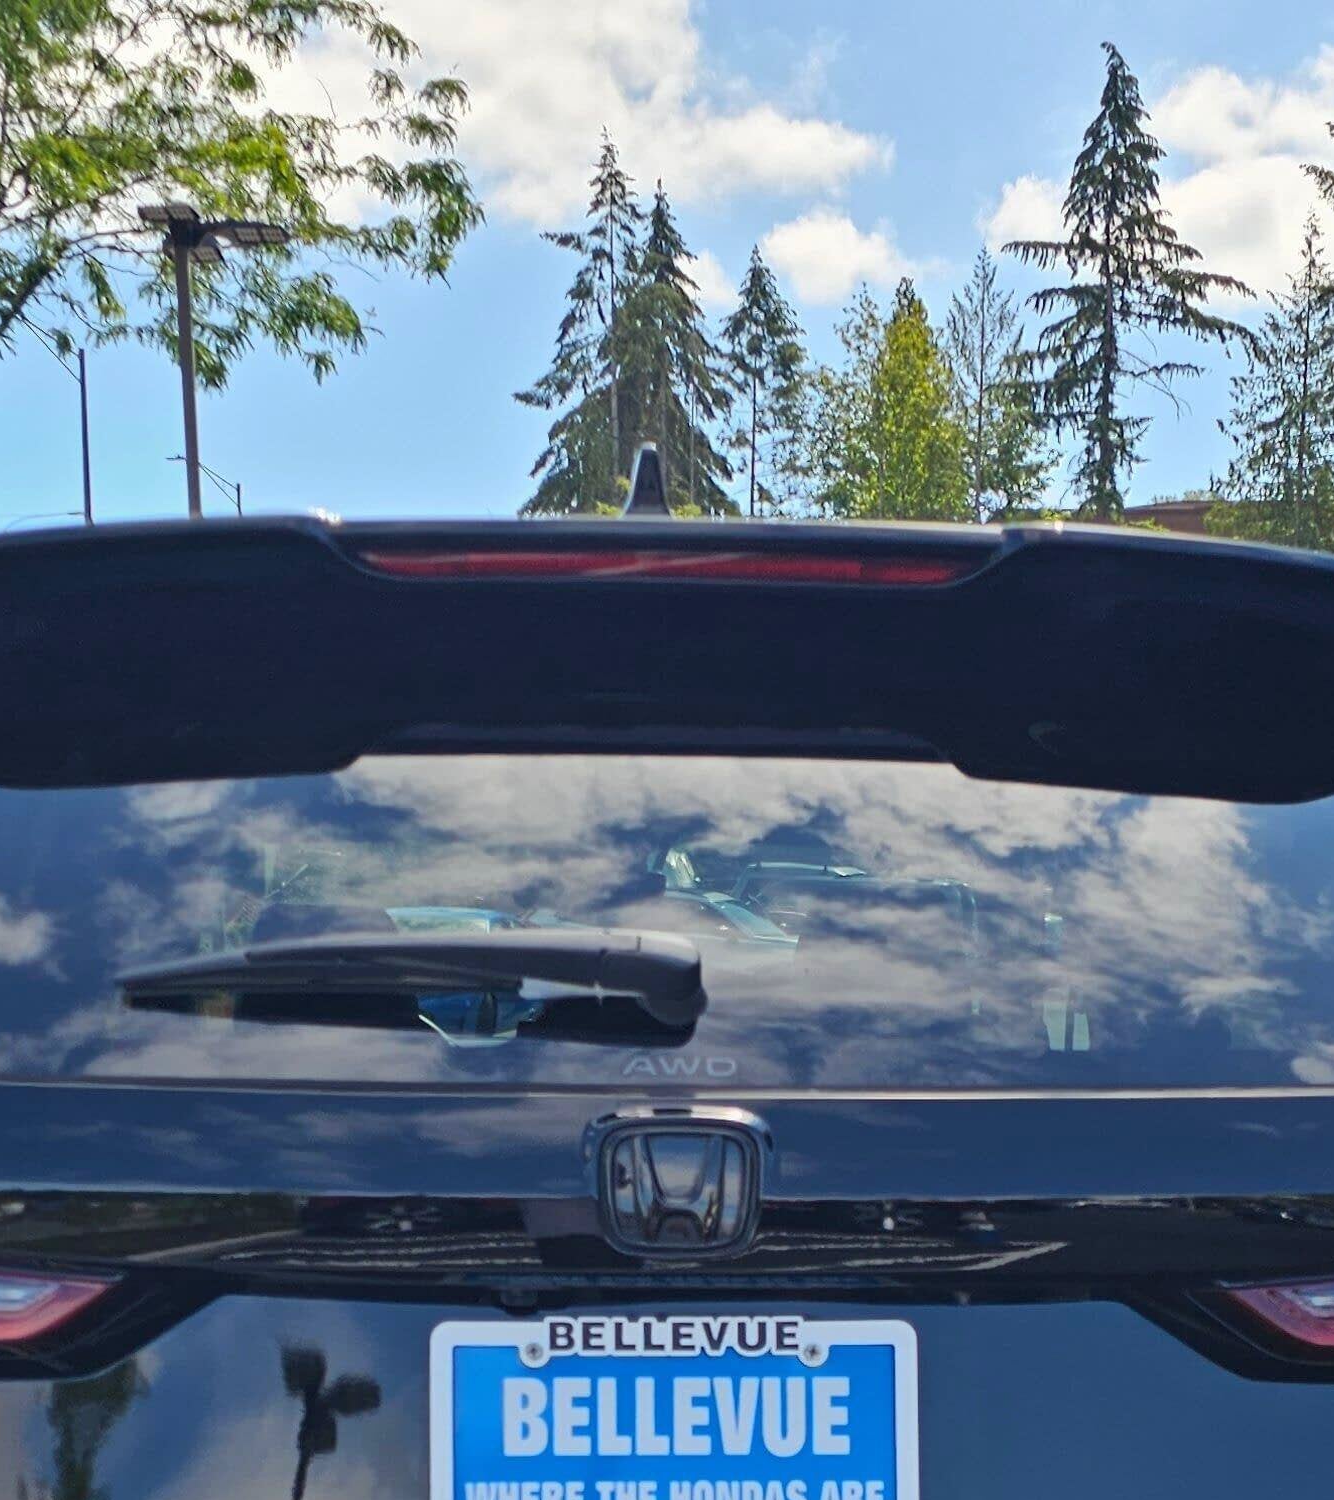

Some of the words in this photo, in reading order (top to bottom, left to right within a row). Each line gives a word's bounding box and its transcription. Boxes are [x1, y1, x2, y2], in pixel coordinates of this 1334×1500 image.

[622, 1055, 738, 1077] AWD
[547, 1321, 800, 1351] BELLEVUE
[503, 1377, 850, 1457] BELLEVUE
